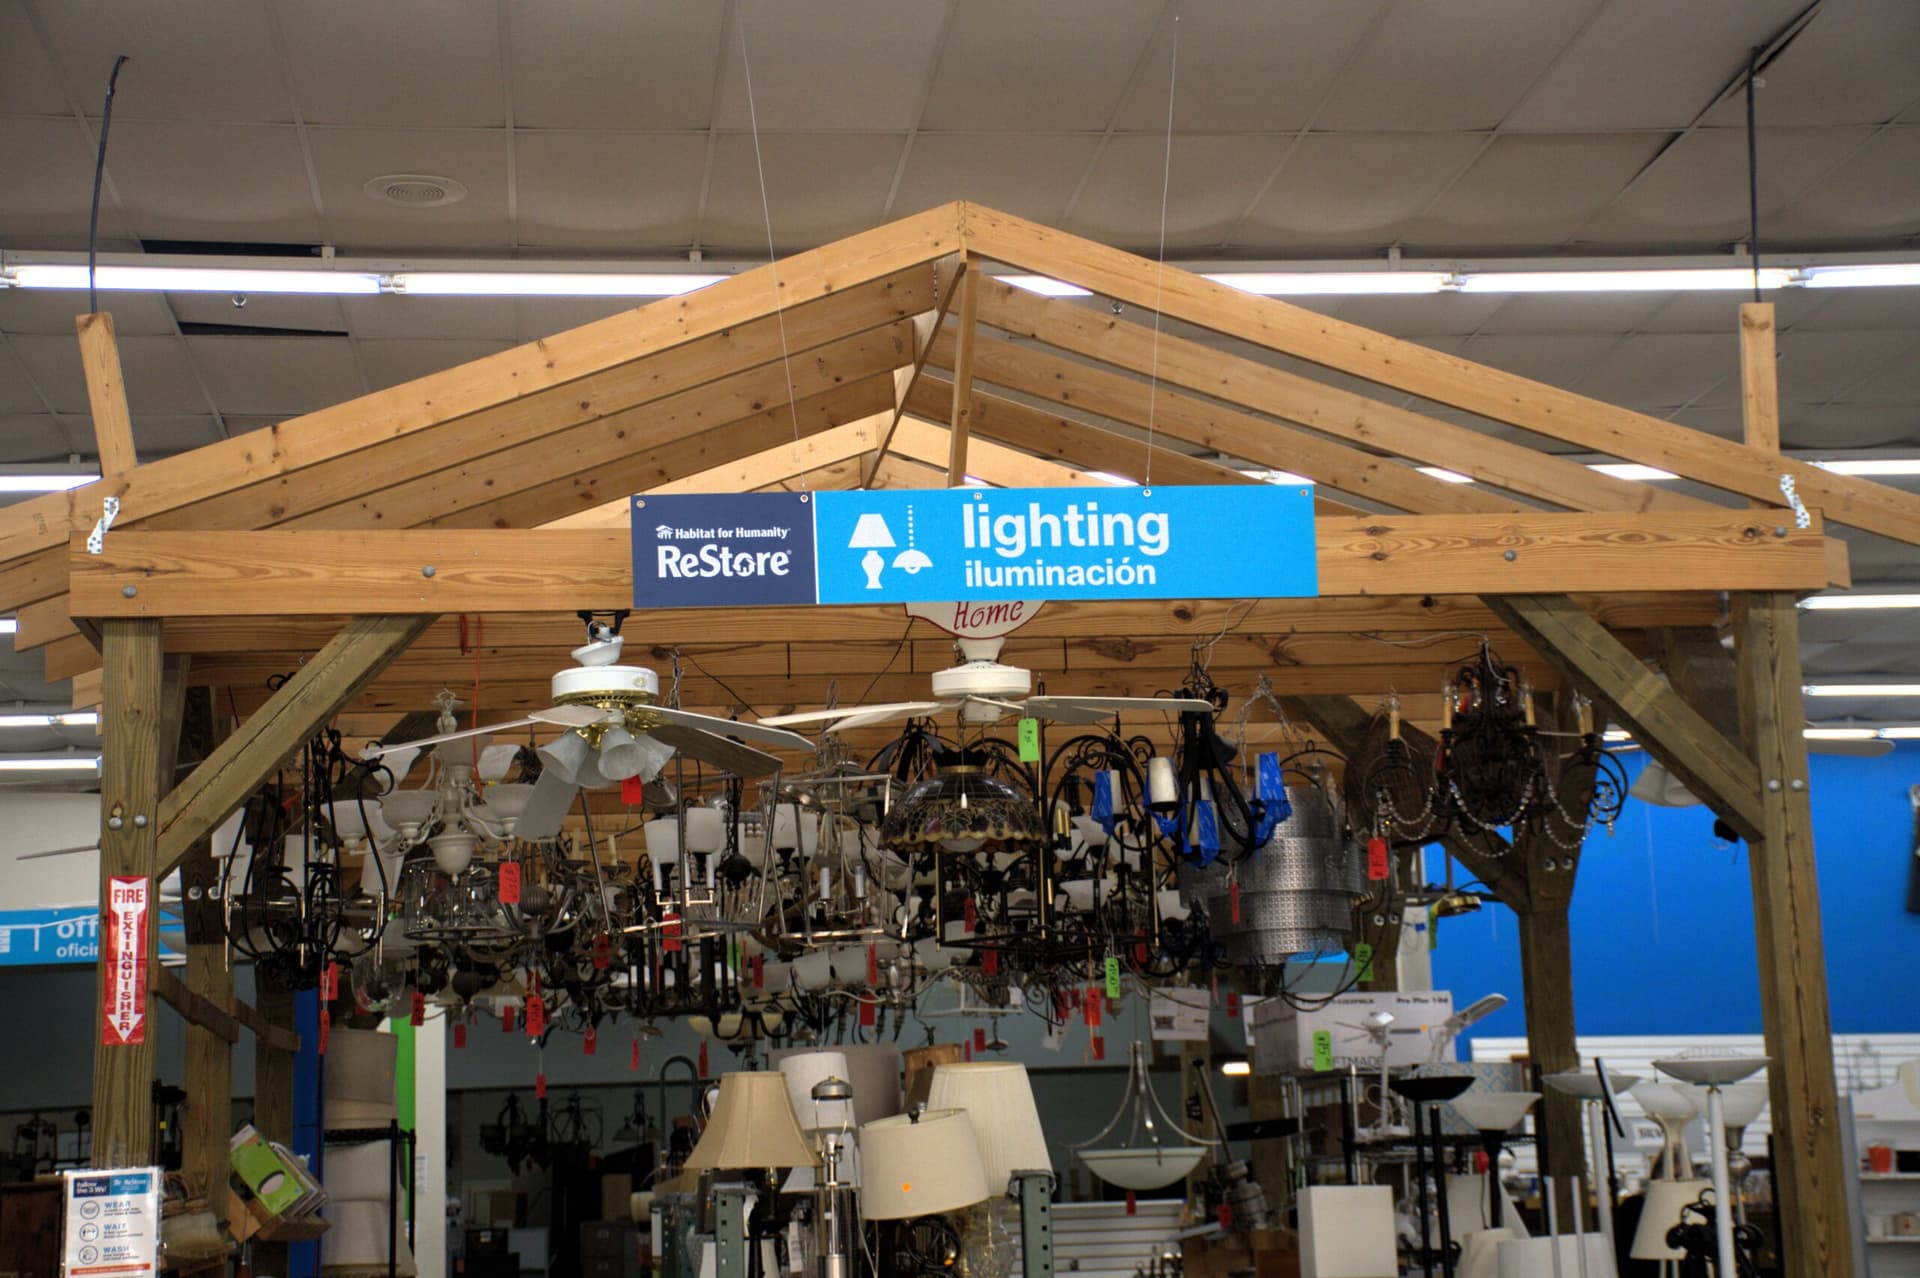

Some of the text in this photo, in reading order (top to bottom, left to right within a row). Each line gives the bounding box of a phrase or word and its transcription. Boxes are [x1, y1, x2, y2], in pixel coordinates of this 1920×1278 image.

[675, 528, 715, 539] Habitat
[717, 527, 734, 538] for
[962, 502, 1170, 558] lighting
[657, 543, 790, 578] ReStore
[965, 557, 1156, 588] iluminación
[954, 600, 1024, 630] Home
[114, 888, 144, 904] FIRE
[56, 917, 99, 939] off
[119, 911, 134, 1031] EXTINGUISHER
[104, 1200, 131, 1209] WEAR
[103, 1223, 126, 1231] WAIT
[103, 1245, 129, 1253] WASH
